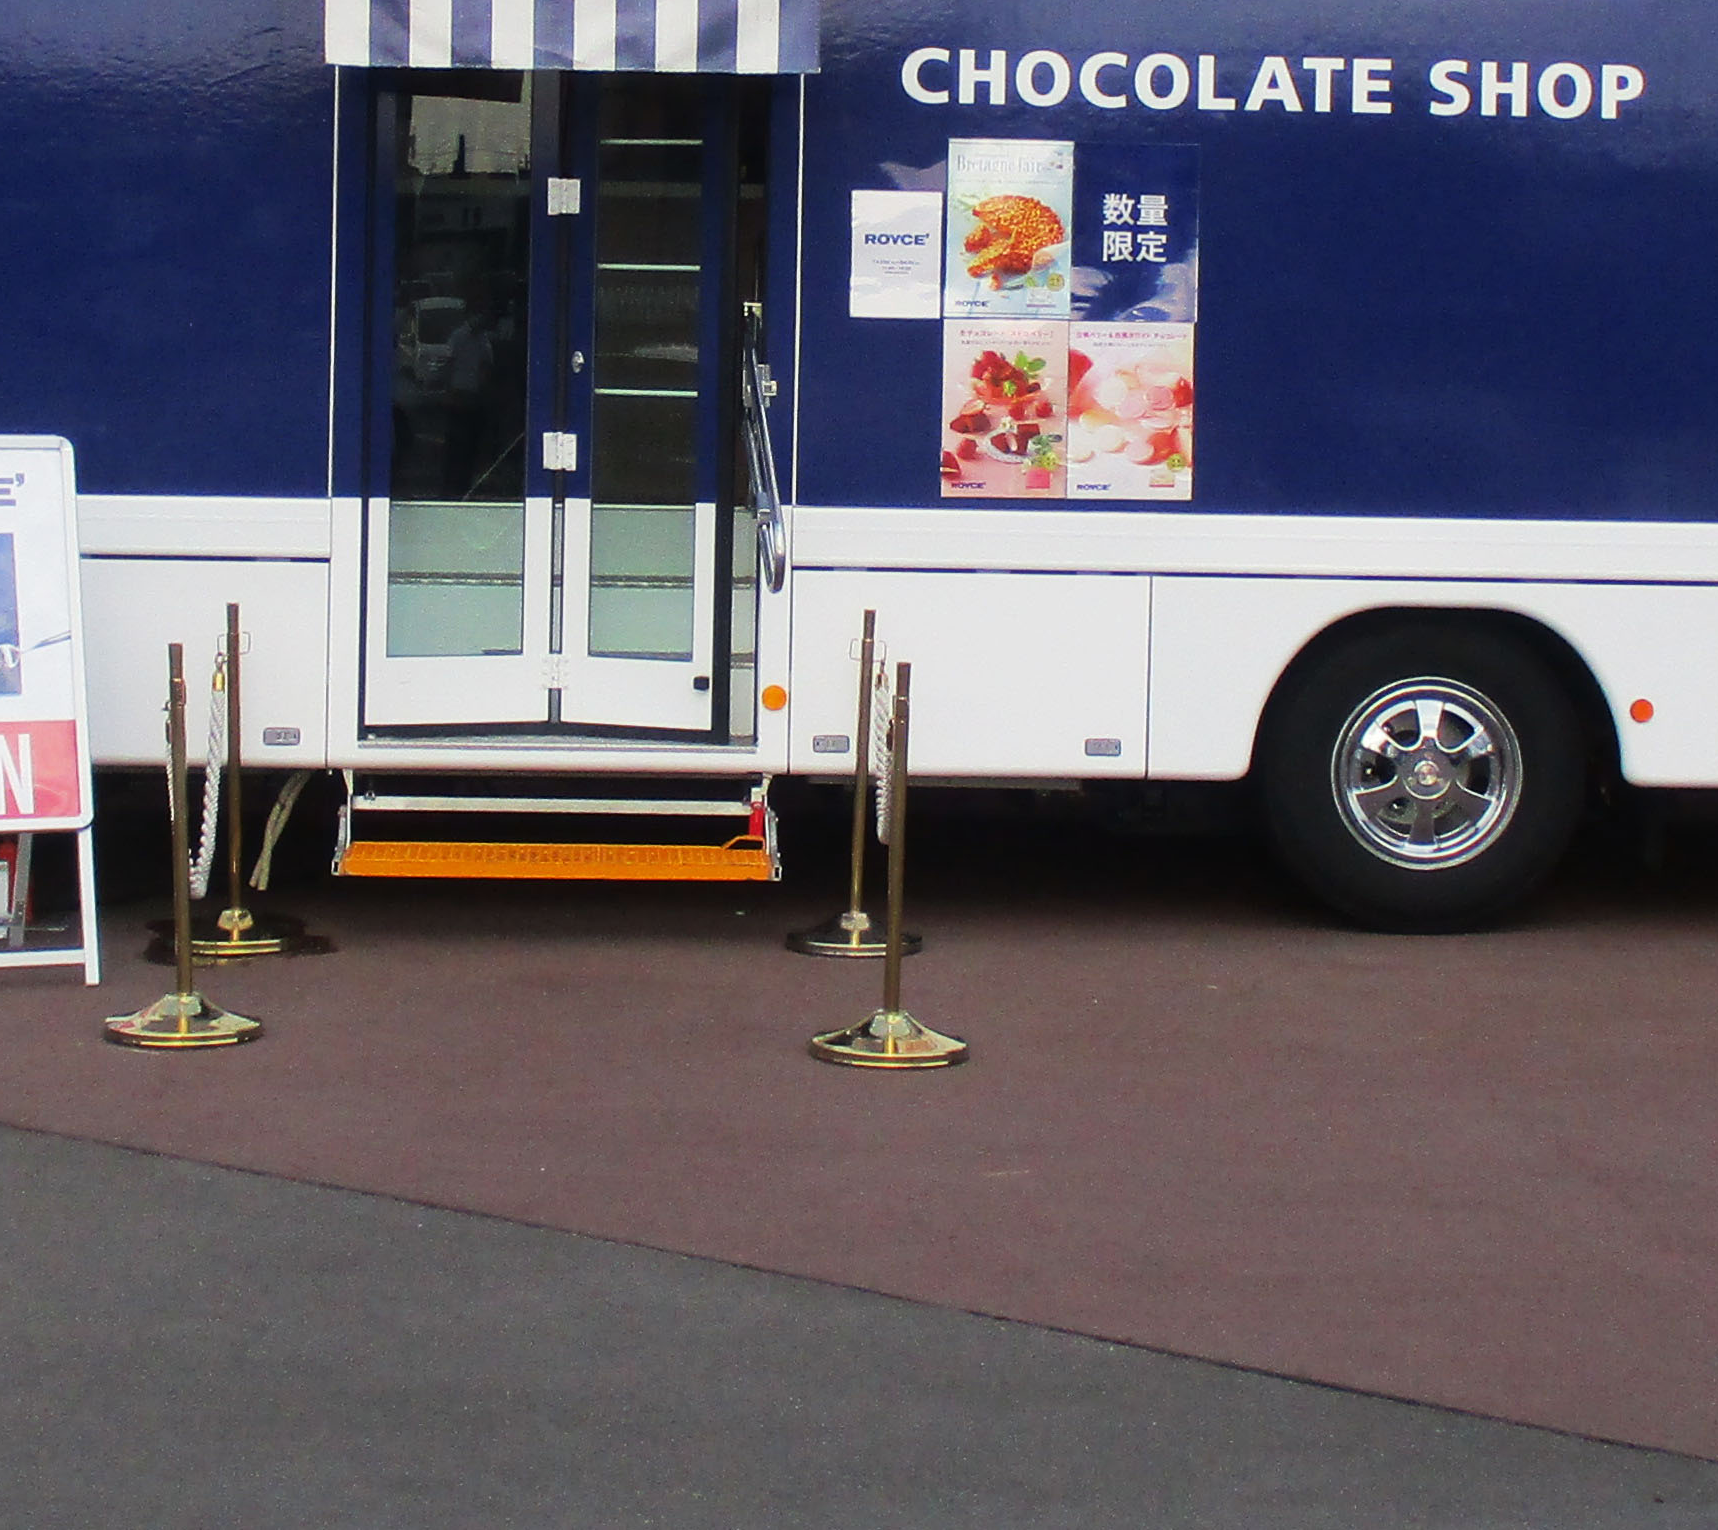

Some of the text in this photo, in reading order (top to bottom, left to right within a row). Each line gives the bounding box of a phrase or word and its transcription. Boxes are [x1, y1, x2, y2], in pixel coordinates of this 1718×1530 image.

[900, 46, 1646, 121] CHOCOLATE SHOP
[1102, 193, 1169, 227] 数量
[1101, 230, 1168, 264] 限定
